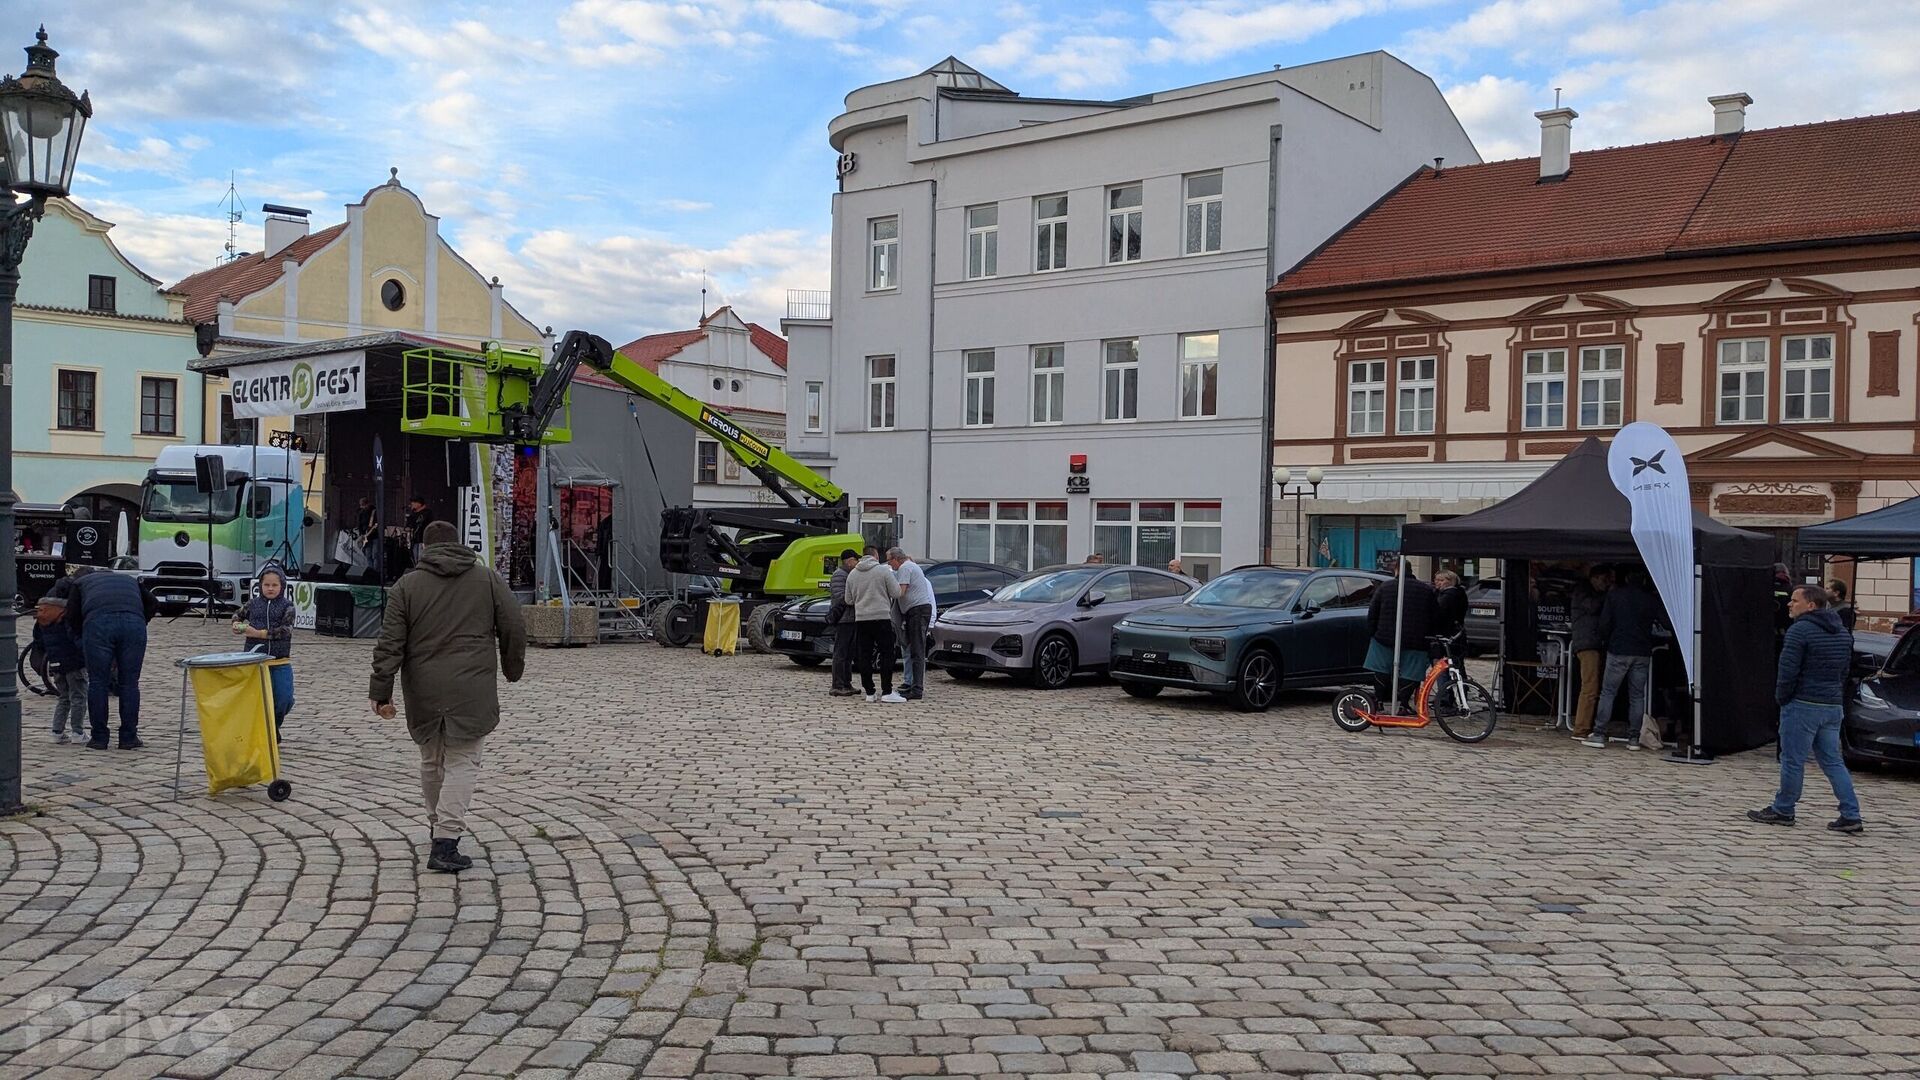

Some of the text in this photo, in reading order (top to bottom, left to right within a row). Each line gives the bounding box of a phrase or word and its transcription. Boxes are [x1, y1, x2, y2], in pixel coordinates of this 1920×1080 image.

[316, 366, 360, 396] FEST
[708, 414, 740, 439] KEROUS
[24, 561, 56, 572] point
